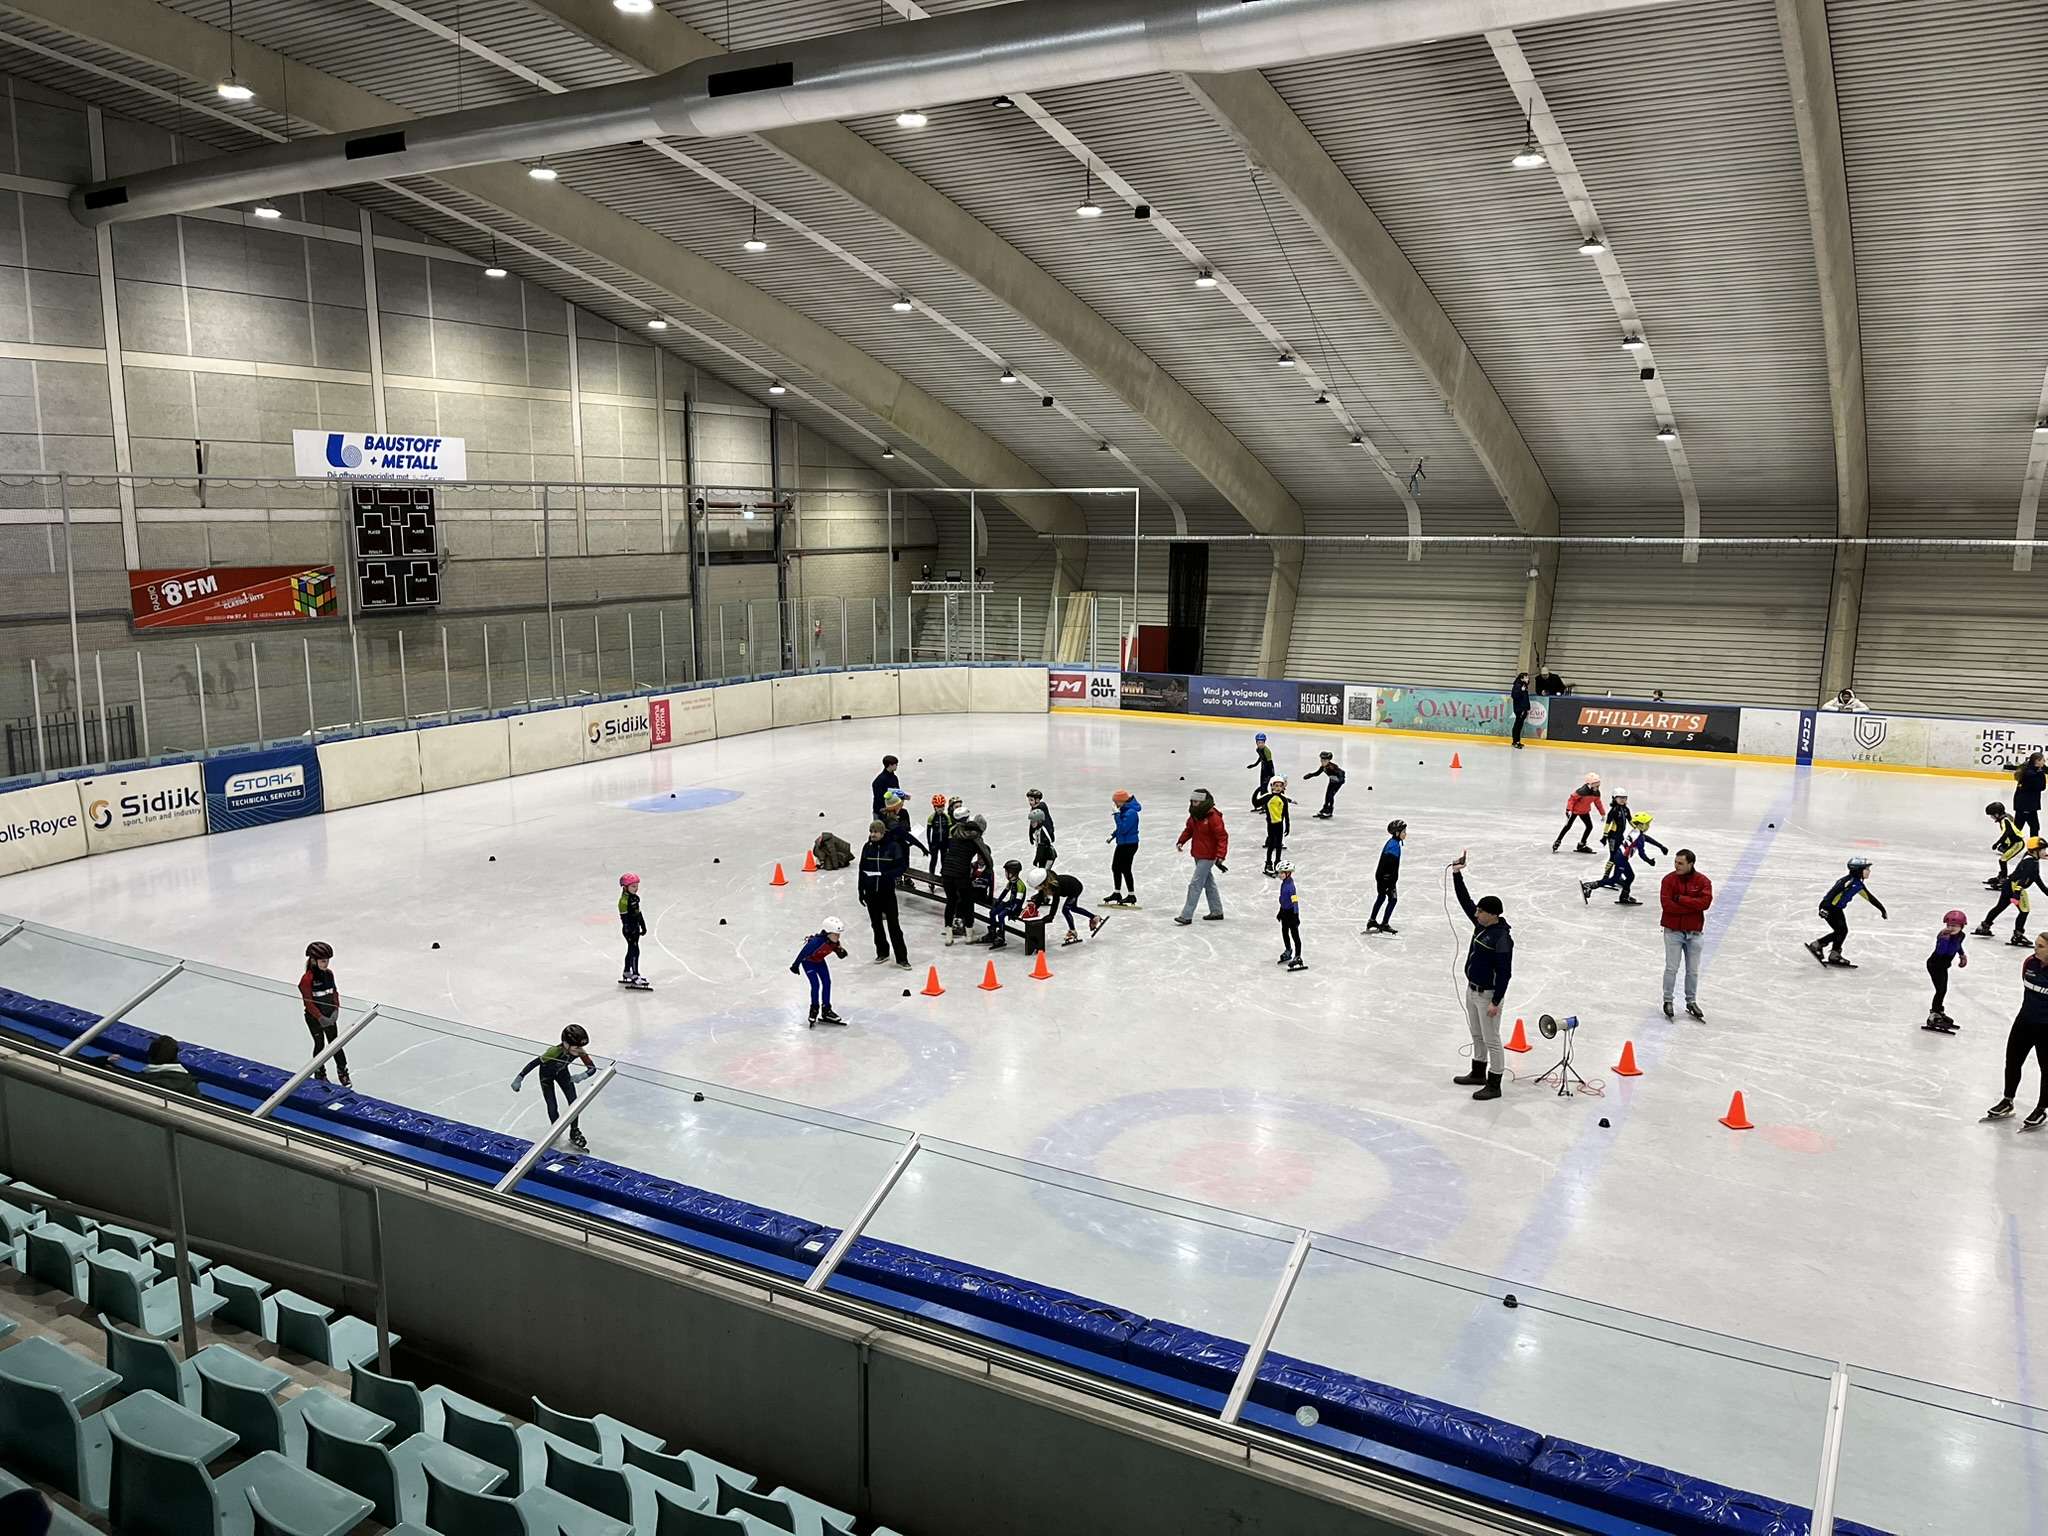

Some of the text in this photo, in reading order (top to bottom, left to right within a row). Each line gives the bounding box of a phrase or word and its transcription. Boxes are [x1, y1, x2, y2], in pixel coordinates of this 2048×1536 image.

[364, 435, 442, 453] BAUSTOFF
[370, 454, 438, 470] + METALL
[148, 585, 161, 611] RADIO
[1091, 678, 1112, 688] ALL
[1203, 687, 1269, 699] Vind je volgende
[1300, 692, 1329, 705] HEILIGE
[1202, 697, 1281, 709] auto op Louwman.nl
[1300, 703, 1338, 716] BOONTJES
[605, 716, 648, 736] Sidijk
[1585, 710, 1700, 730] THILLART'S
[1802, 717, 1812, 752] CCM
[1983, 729, 2016, 741] HET
[1982, 741, 2048, 755] SCHEID
[233, 773, 293, 792] STORK
[120, 787, 201, 817] Sidijk
[231, 789, 301, 807] TECHNICAL SERVICES
[123, 807, 201, 827] sport, fun and industry
